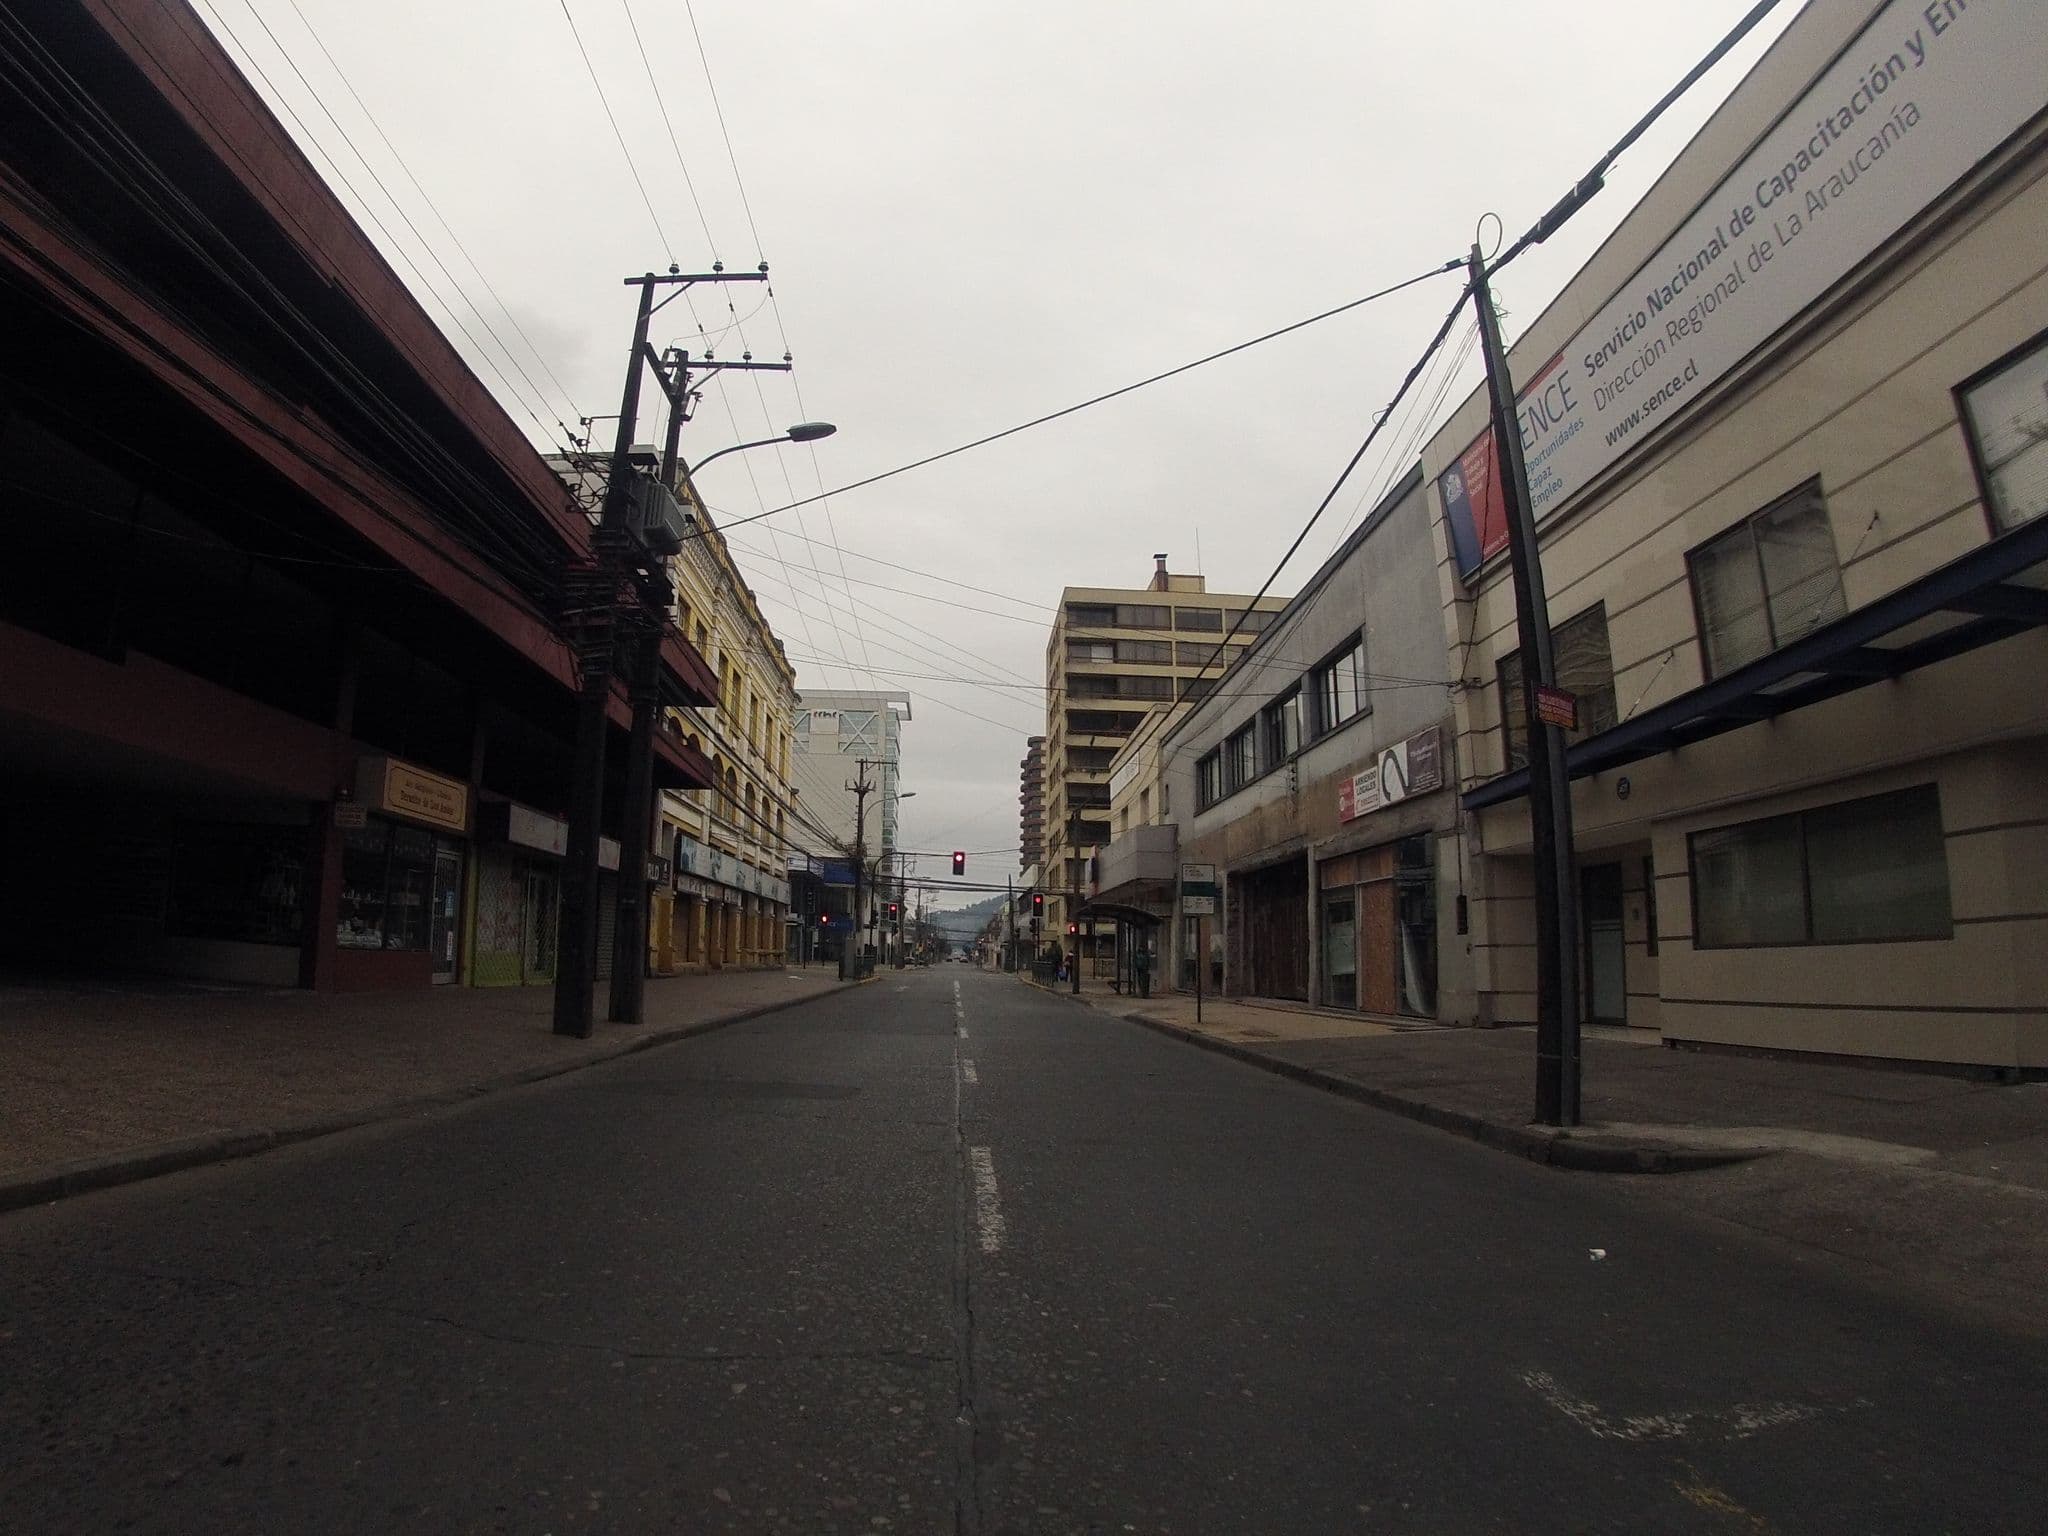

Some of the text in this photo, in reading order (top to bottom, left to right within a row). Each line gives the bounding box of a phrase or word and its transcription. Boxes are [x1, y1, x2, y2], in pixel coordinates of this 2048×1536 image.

[1583, 311, 1647, 378] Servicio
[1646, 226, 1729, 318] Nacional
[1729, 204, 1756, 239] de
[1756, 52, 1907, 210] Capacitación
[1904, 29, 1926, 69] y
[1593, 101, 1921, 412] Dirección Regional de La Araucanía
[1605, 357, 1700, 448] www.sence.cl
[1531, 477, 1563, 509] Empleo
[1356, 780, 1377, 796] LOCALES
